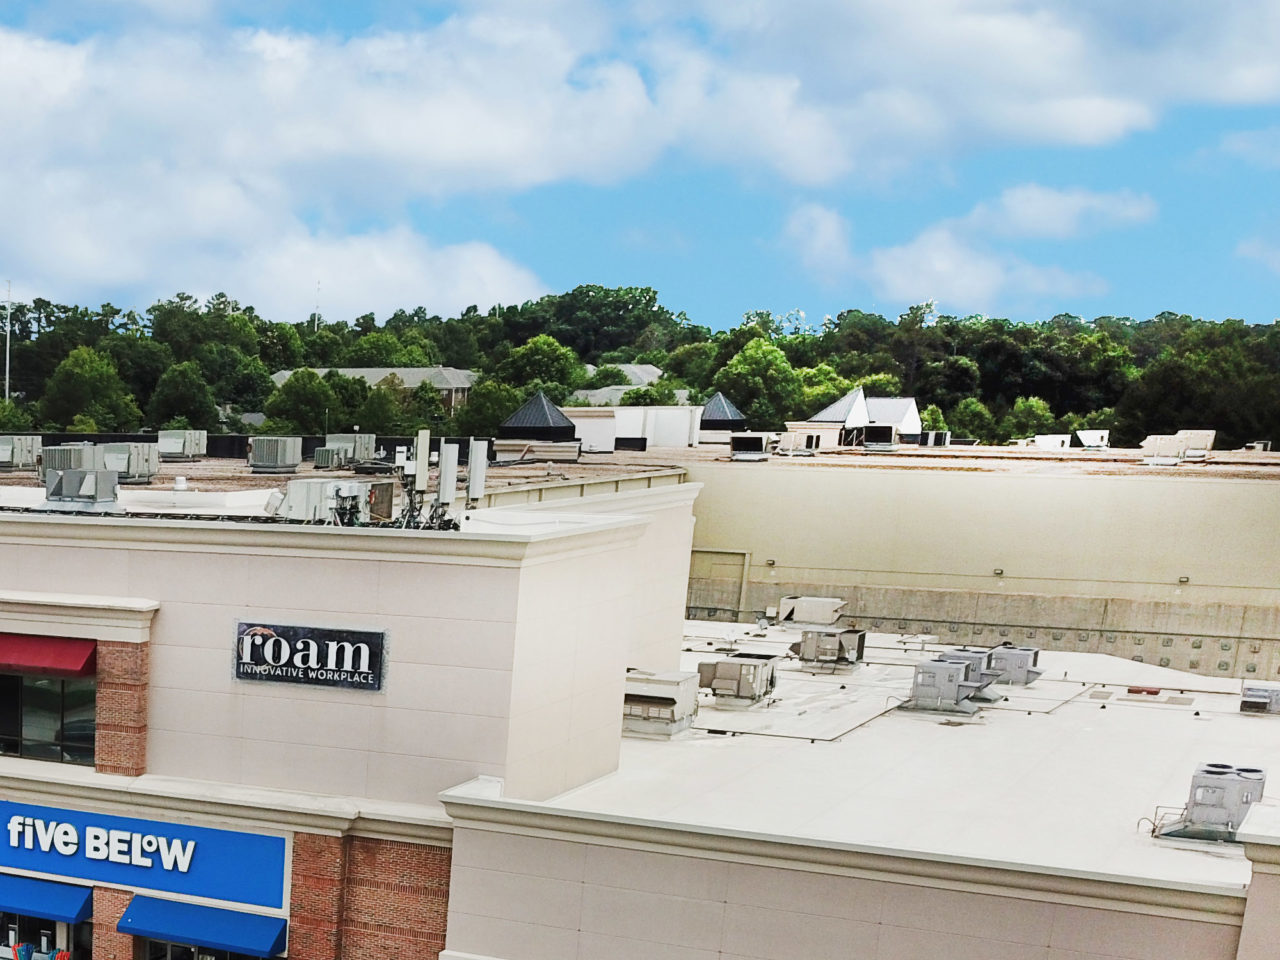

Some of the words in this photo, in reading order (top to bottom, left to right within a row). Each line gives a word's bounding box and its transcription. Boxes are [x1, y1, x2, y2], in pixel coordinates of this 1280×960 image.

[239, 634, 373, 673] roam
[240, 664, 304, 678] INNOVATIVE
[307, 669, 374, 684] WORKPLACE
[7, 815, 79, 856] five
